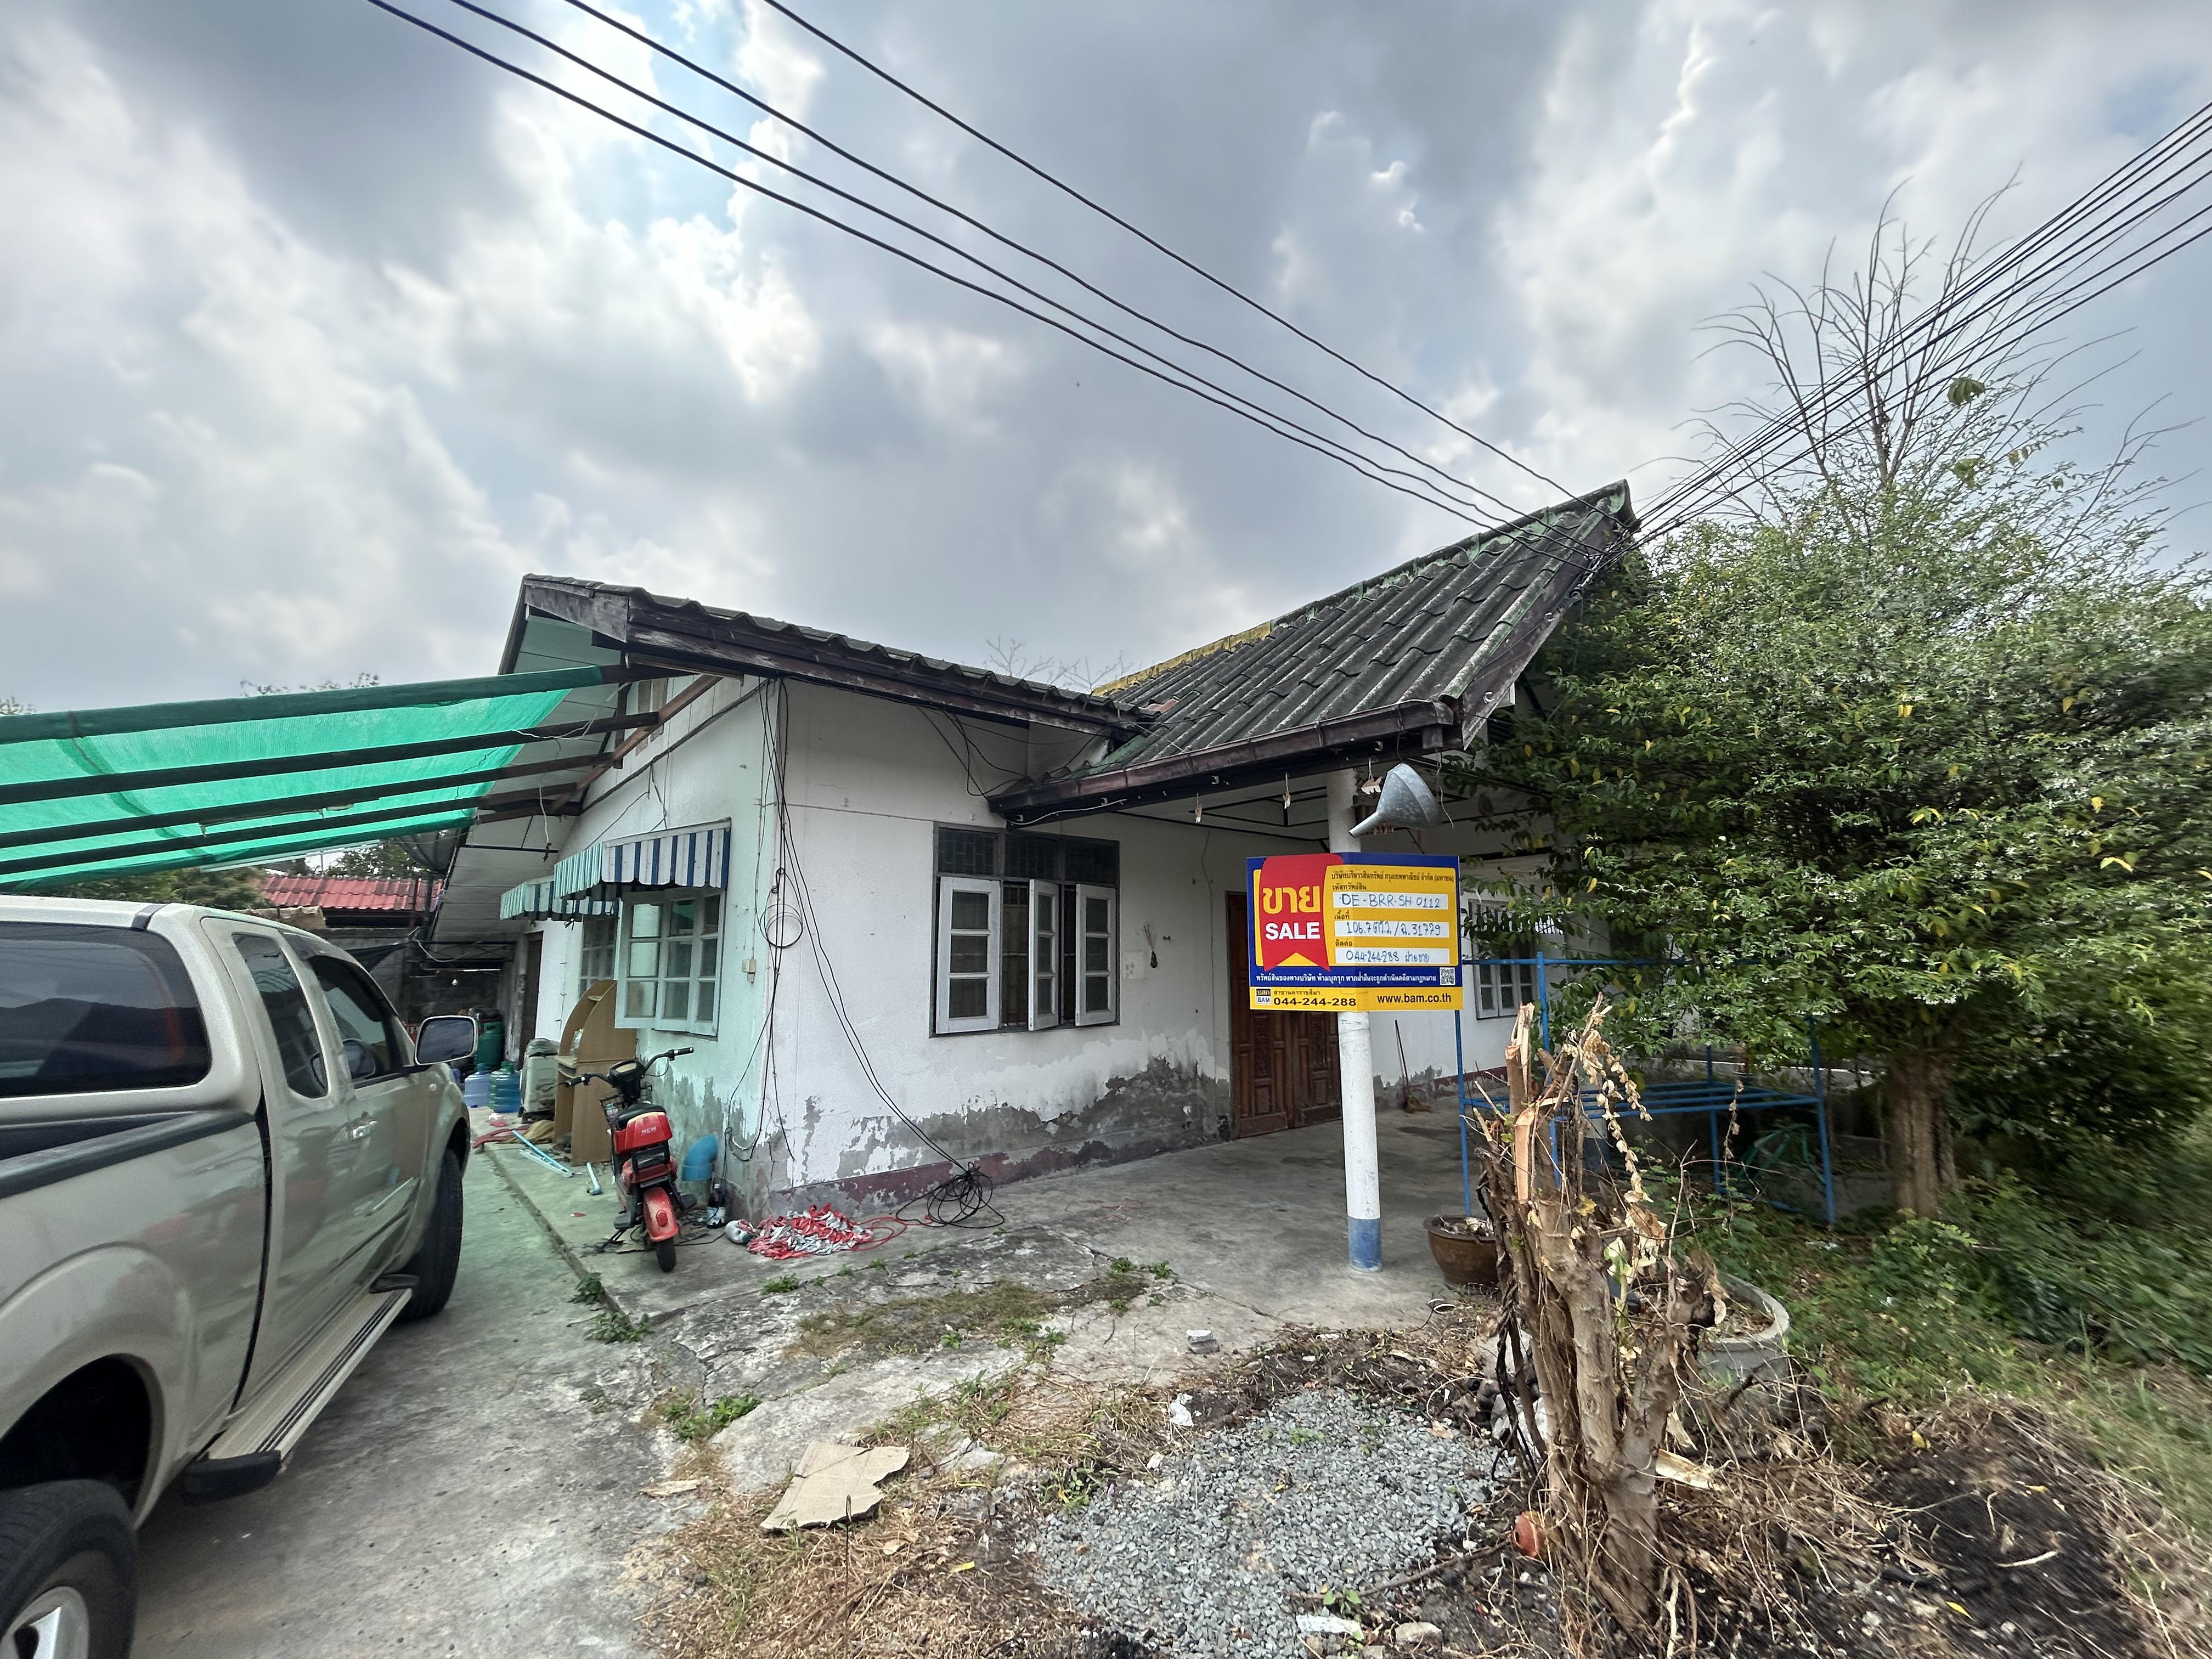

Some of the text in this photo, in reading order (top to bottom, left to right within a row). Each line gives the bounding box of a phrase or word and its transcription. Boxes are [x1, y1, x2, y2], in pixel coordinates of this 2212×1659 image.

[1262, 885, 1321, 914] ขาย
[1334, 910, 1350, 919] เนื้อที่
[1265, 922, 1321, 940] SALE
[1335, 938, 1352, 946] ติดต่อ
[1273, 997, 1357, 1007] 044-244-288
[1377, 993, 1452, 1003] www.bam.co.th
